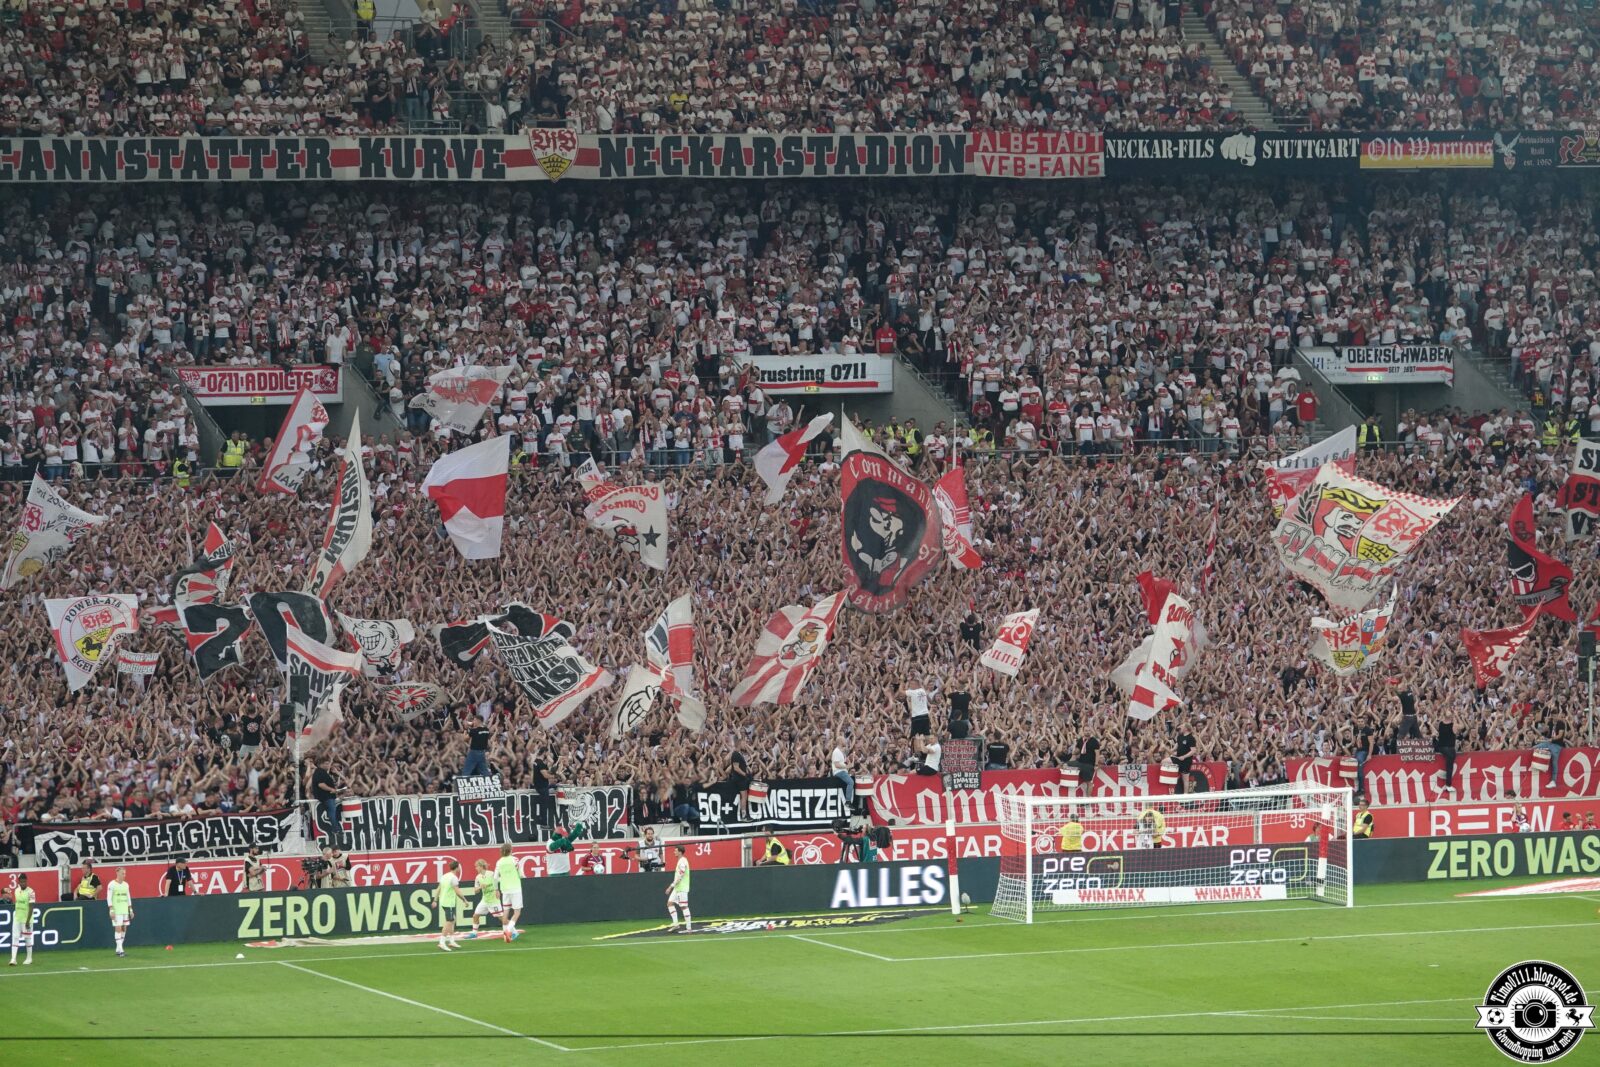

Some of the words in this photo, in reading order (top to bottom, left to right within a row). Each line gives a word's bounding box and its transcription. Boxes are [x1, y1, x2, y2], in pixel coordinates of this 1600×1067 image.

[978, 131, 1102, 153] ALBSTADT
[1105, 138, 1215, 159] NECKAR-FILS
[1262, 137, 1360, 159] STUTTGART
[358, 137, 505, 179] KURVE
[599, 134, 966, 177] NECKARSTADION
[980, 155, 1100, 176] VFB-FANS
[755, 366, 825, 385] rustring
[830, 362, 867, 381] 0711
[457, 775, 501, 787] ULTRAS
[458, 785, 502, 795] BEDEUTET
[1289, 814, 1306, 829] 35
[76, 815, 281, 857] HOOLIGANS
[695, 842, 711, 856] 34
[1230, 848, 1272, 868] pre
[1427, 838, 1516, 879] ZERO
[1043, 856, 1086, 877] pre
[1230, 868, 1287, 885] zero
[830, 864, 946, 909] ALLES
[1078, 888, 1146, 902] WINAMAX
[1194, 886, 1263, 901] WINAMAX
[237, 894, 336, 939] ZERO
